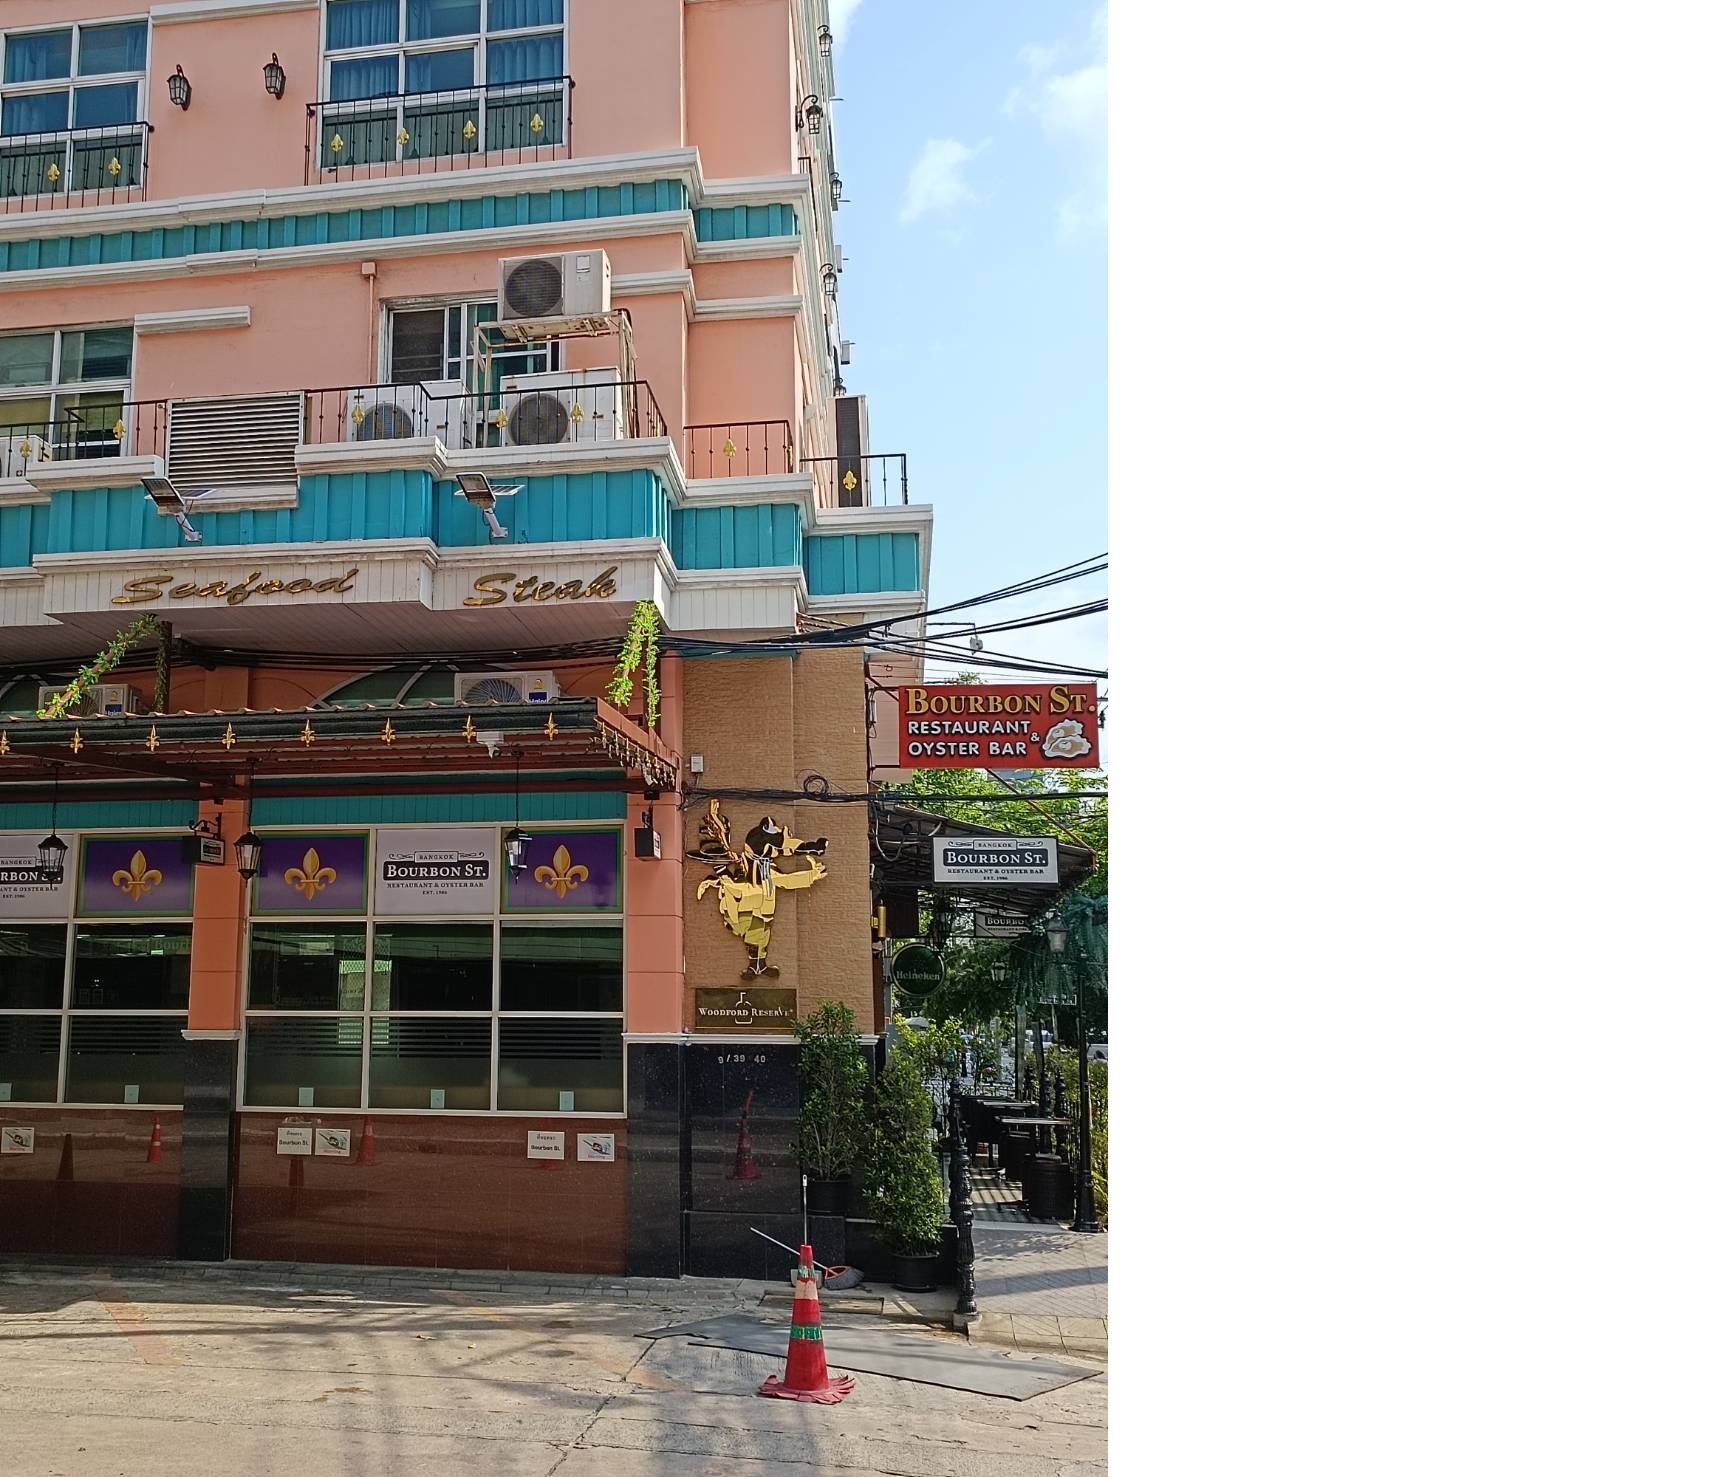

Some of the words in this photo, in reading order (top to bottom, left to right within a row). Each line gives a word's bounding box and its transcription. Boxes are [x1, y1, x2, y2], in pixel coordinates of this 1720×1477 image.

[111, 568, 359, 606] Seafood
[463, 565, 618, 606] Steak
[906, 688, 1042, 715] BOURBON
[1050, 686, 1096, 713] ST.
[908, 720, 1031, 735] RESTAURANT
[1030, 732, 1040, 742] &
[908, 742, 980, 756] OYSTER
[989, 741, 1027, 755] BAR
[946, 851, 1020, 864] BOURBON
[1024, 851, 1046, 864] ST.
[0, 871, 39, 881] RBON
[387, 864, 461, 877] BOURBON
[464, 863, 486, 877] ST.
[896, 969, 940, 981] Heineken
[699, 1007, 749, 1017] WOODFORD
[754, 1055, 766, 1064] 40
